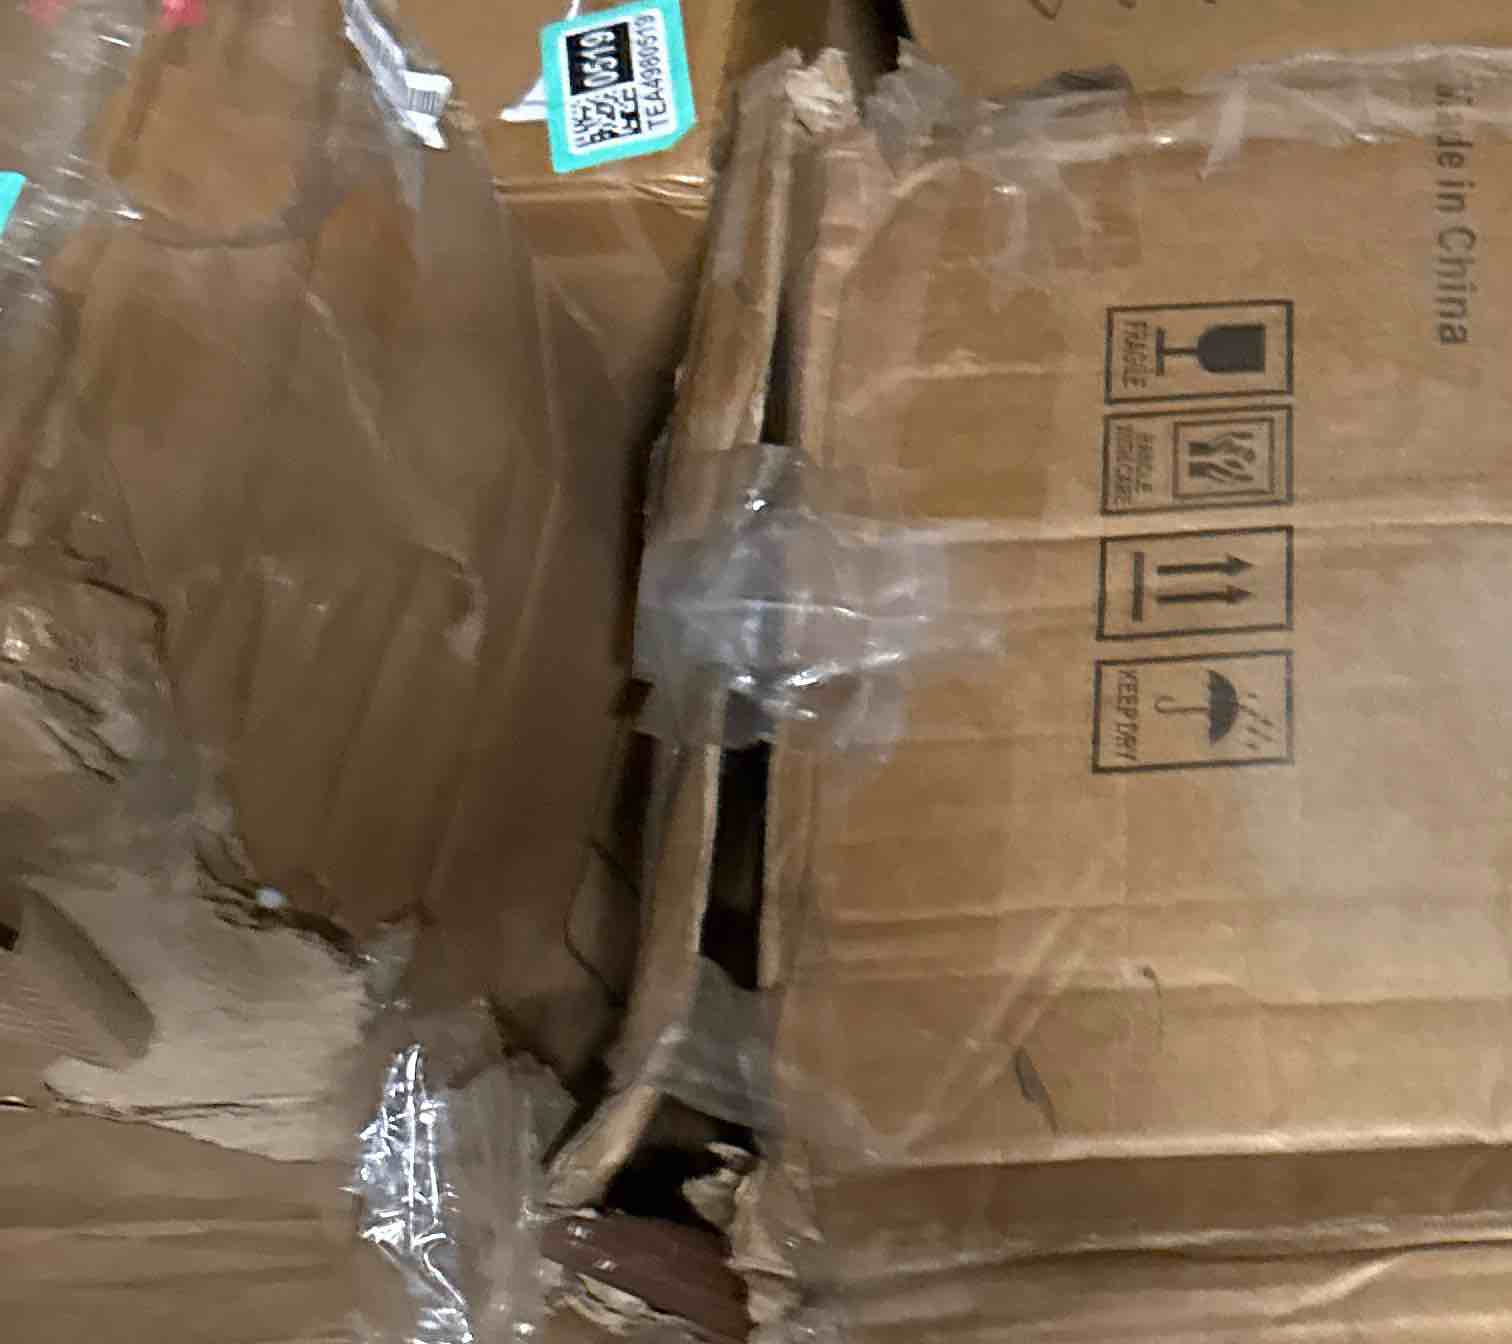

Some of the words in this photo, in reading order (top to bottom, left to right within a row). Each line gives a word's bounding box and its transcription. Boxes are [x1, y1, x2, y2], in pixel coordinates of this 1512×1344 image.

[580, 30, 620, 87] 0519
[1437, 179, 1476, 212] in
[1435, 226, 1477, 345] China
[1120, 320, 1149, 390] FRAGILE
[1116, 669, 1141, 720] KEEP
